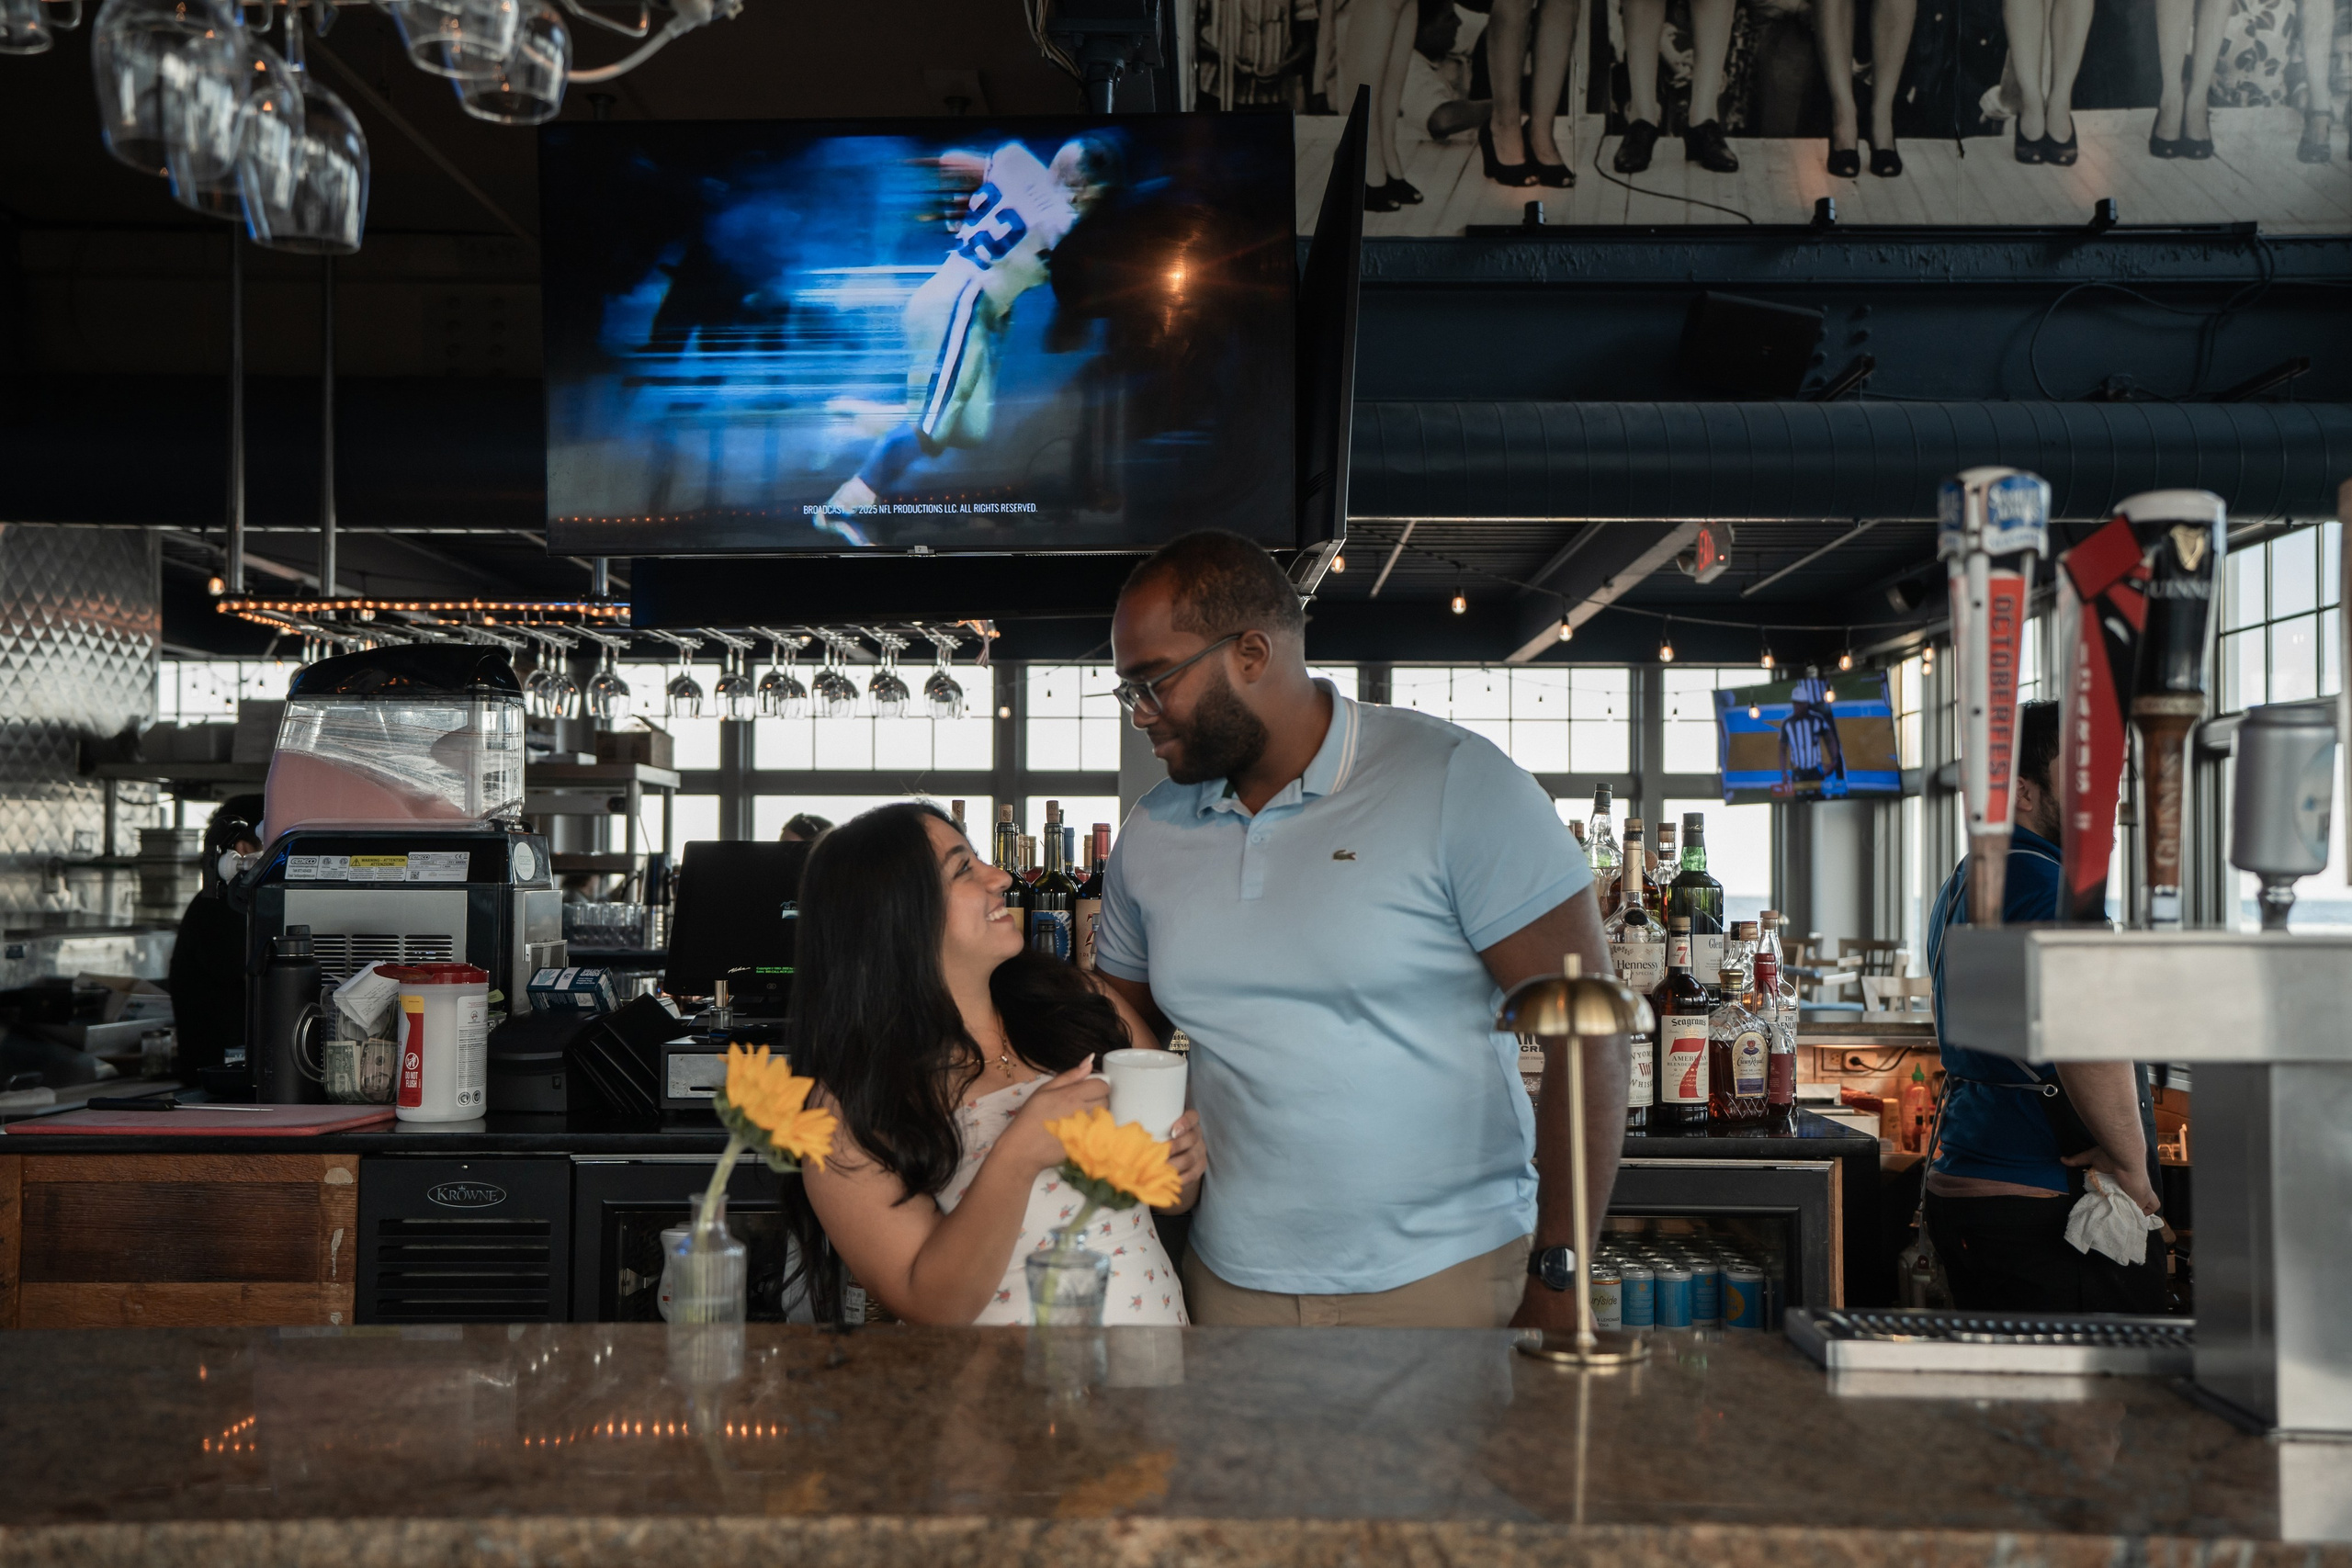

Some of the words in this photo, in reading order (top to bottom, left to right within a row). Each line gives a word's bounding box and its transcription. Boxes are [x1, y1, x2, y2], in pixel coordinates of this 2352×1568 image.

[858, 504, 877, 514] 2025
[879, 504, 891, 514] NFL
[893, 503, 943, 513] PRODUCTIONS
[944, 503, 958, 513] LLC.
[960, 503, 972, 513] ALL
[974, 502, 999, 513] RIGHTS
[1001, 502, 1038, 513] RESERVED.
[1989, 595, 2014, 792] OCTOBERFEST
[2075, 641, 2092, 795] ICARUS
[1677, 946, 1689, 964] 7
[1617, 959, 1658, 972] Hennessy
[1671, 1017, 1707, 1027] Seagram's
[1668, 1036, 1707, 1099] 7
[405, 1071, 411, 1079] DO
[411, 1071, 419, 1079] NOT
[405, 1079, 417, 1089] FLUSH
[436, 1187, 498, 1201] KROWNE
[1590, 1295, 1618, 1306] urfside
